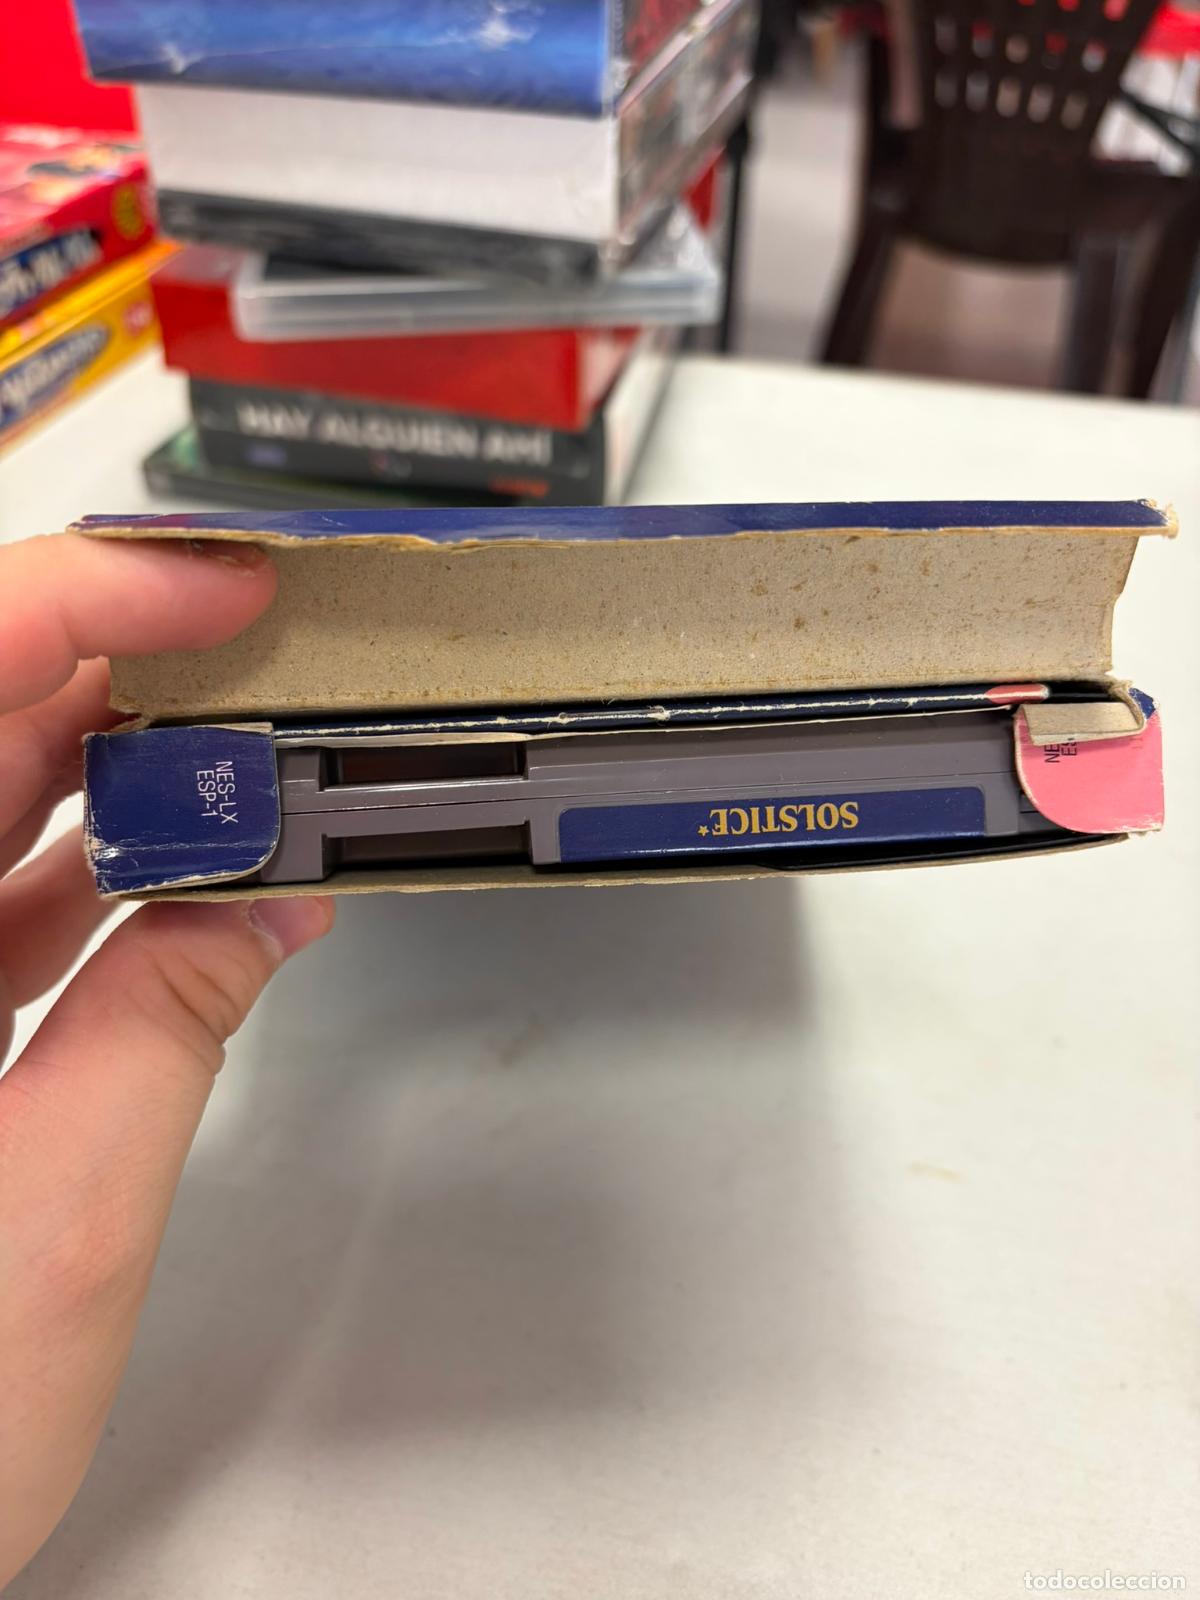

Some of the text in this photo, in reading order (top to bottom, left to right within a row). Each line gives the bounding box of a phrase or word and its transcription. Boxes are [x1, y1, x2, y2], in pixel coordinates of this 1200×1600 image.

[197, 770, 218, 816] ESP-1
[215, 761, 239, 824] NES-LX
[709, 801, 859, 836] SOLSTICE
